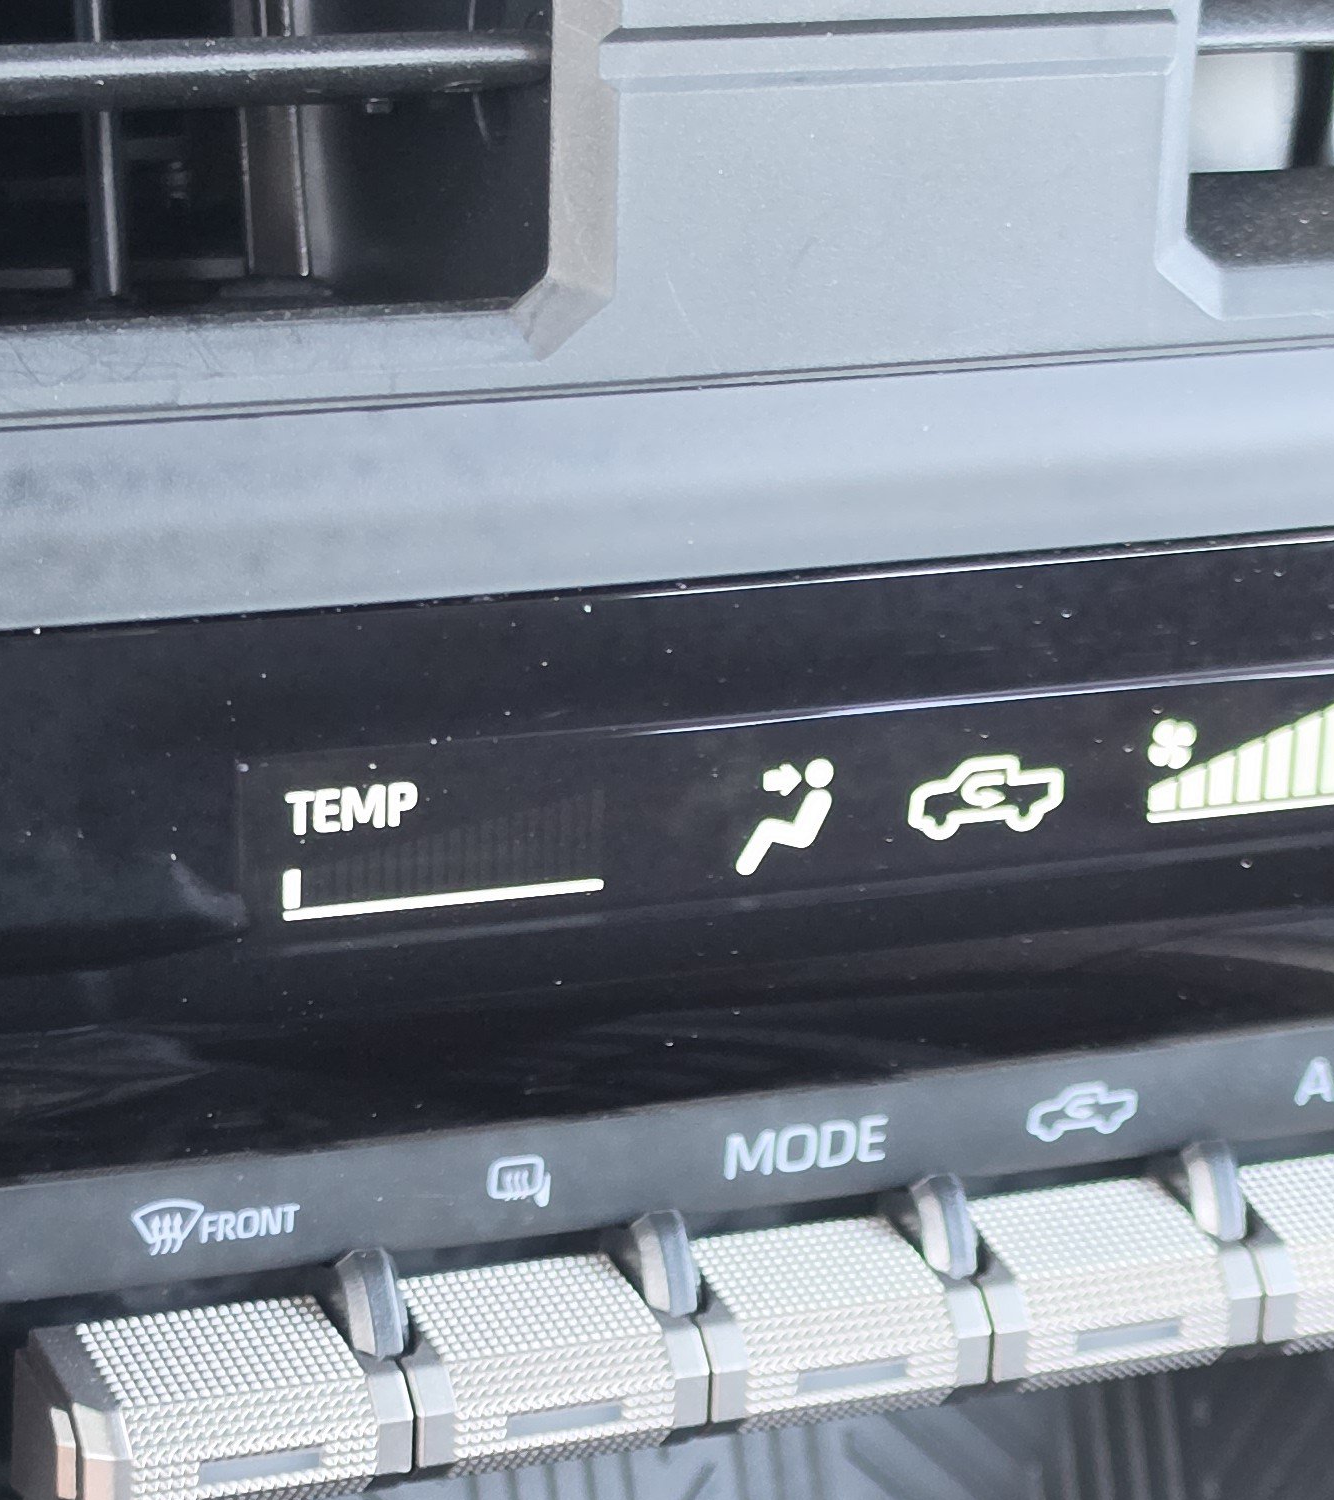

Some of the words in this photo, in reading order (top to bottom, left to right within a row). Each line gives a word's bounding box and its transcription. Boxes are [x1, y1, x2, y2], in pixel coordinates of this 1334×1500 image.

[284, 781, 419, 836] TEMP
[725, 1115, 887, 1180] MODE
[200, 1202, 301, 1244] FRONT
